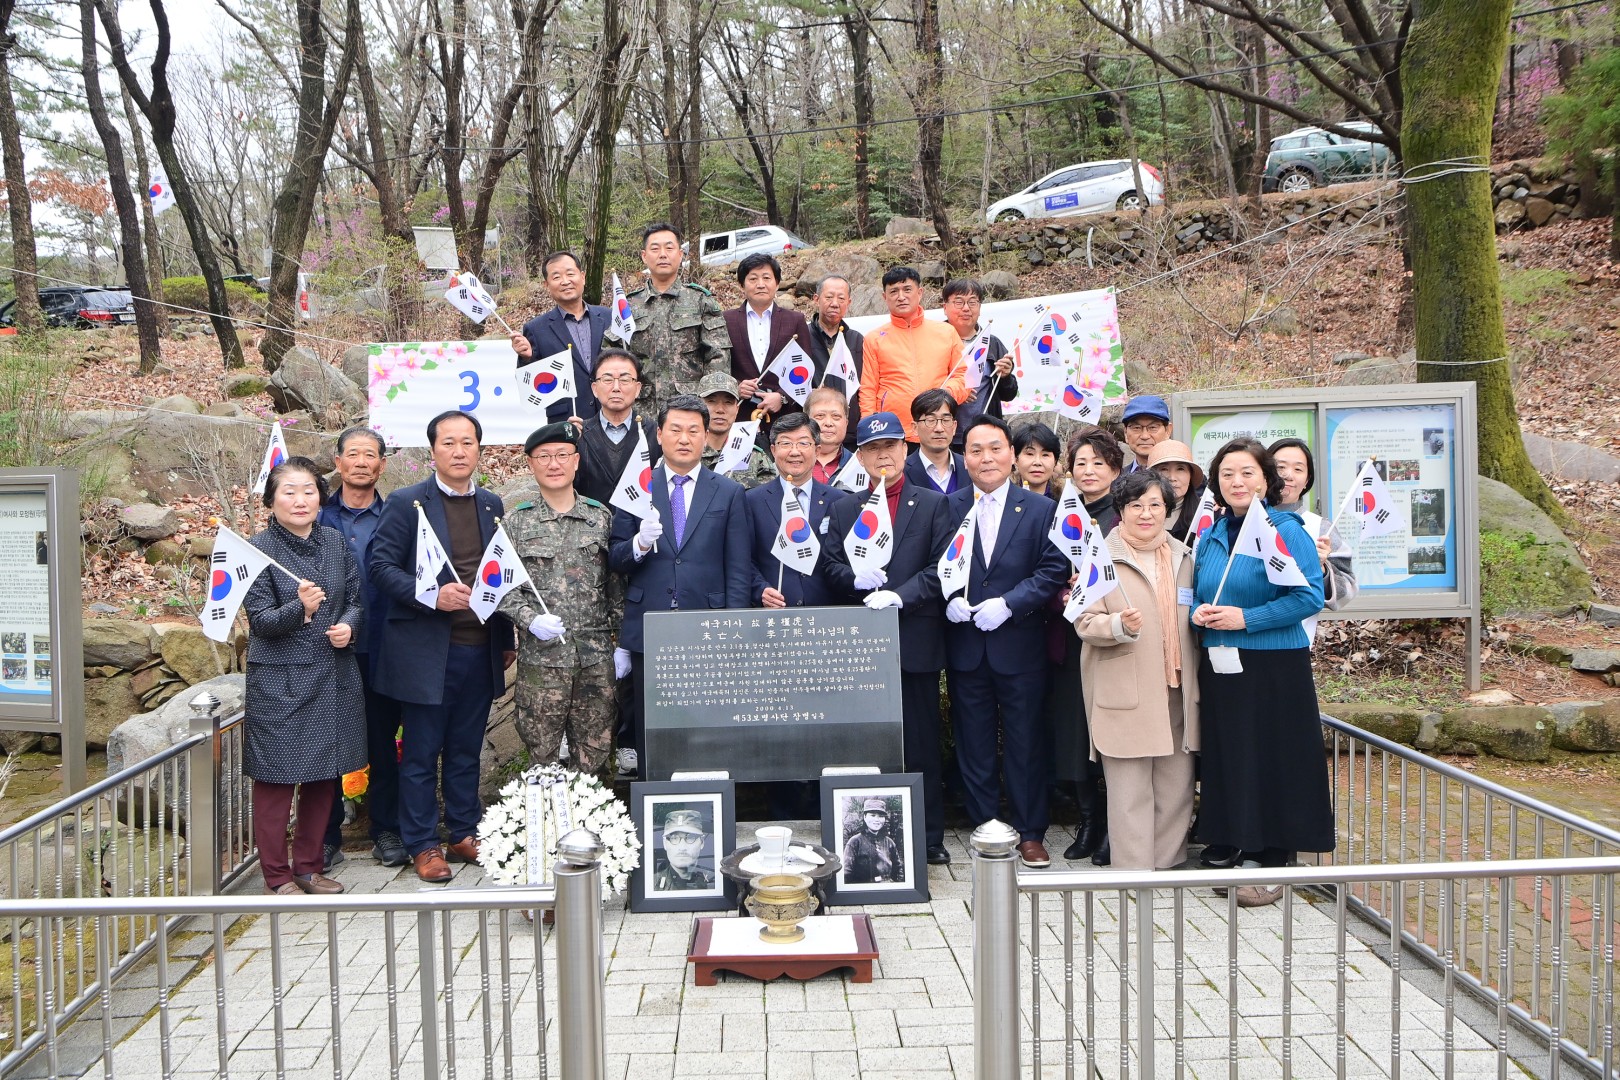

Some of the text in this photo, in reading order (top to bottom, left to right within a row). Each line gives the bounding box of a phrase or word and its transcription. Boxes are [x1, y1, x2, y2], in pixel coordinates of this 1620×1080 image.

[1203, 431, 1230, 440] 애국지사
[1254, 430, 1268, 439] 선생
[1269, 428, 1297, 438] 주요연보
[700, 619, 743, 629] 애국지사
[751, 618, 760, 628] 故
[807, 615, 815, 626] 님
[702, 631, 743, 641] 未亡人
[807, 626, 845, 637] 여사님의
